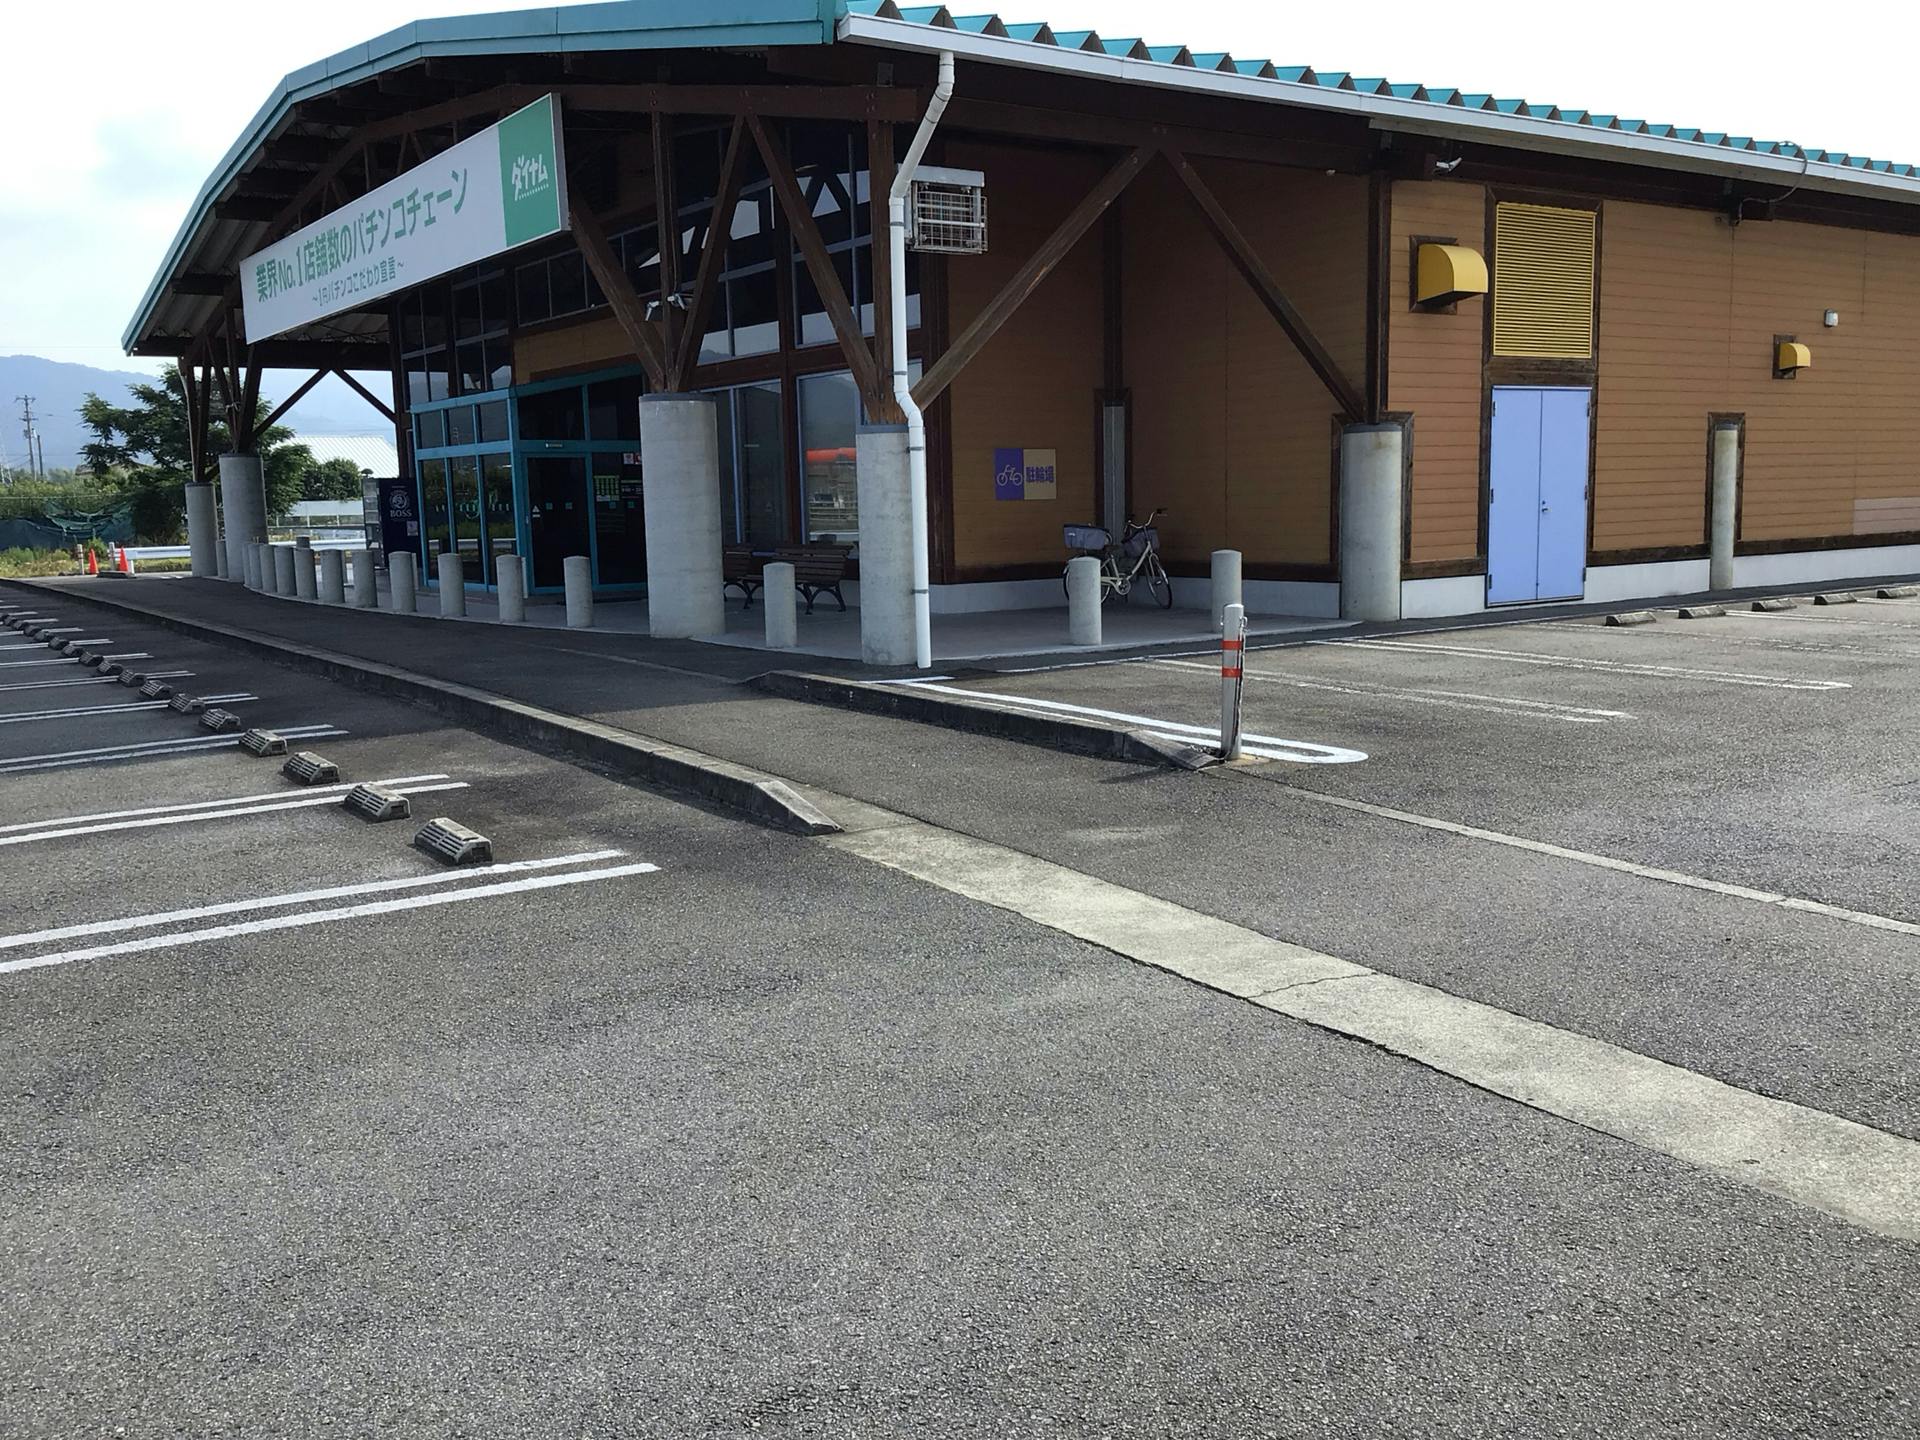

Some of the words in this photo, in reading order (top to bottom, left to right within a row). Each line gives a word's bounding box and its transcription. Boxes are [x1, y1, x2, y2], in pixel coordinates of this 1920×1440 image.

[512, 154, 549, 201] ダイナム
[390, 509, 413, 518] BOSS
